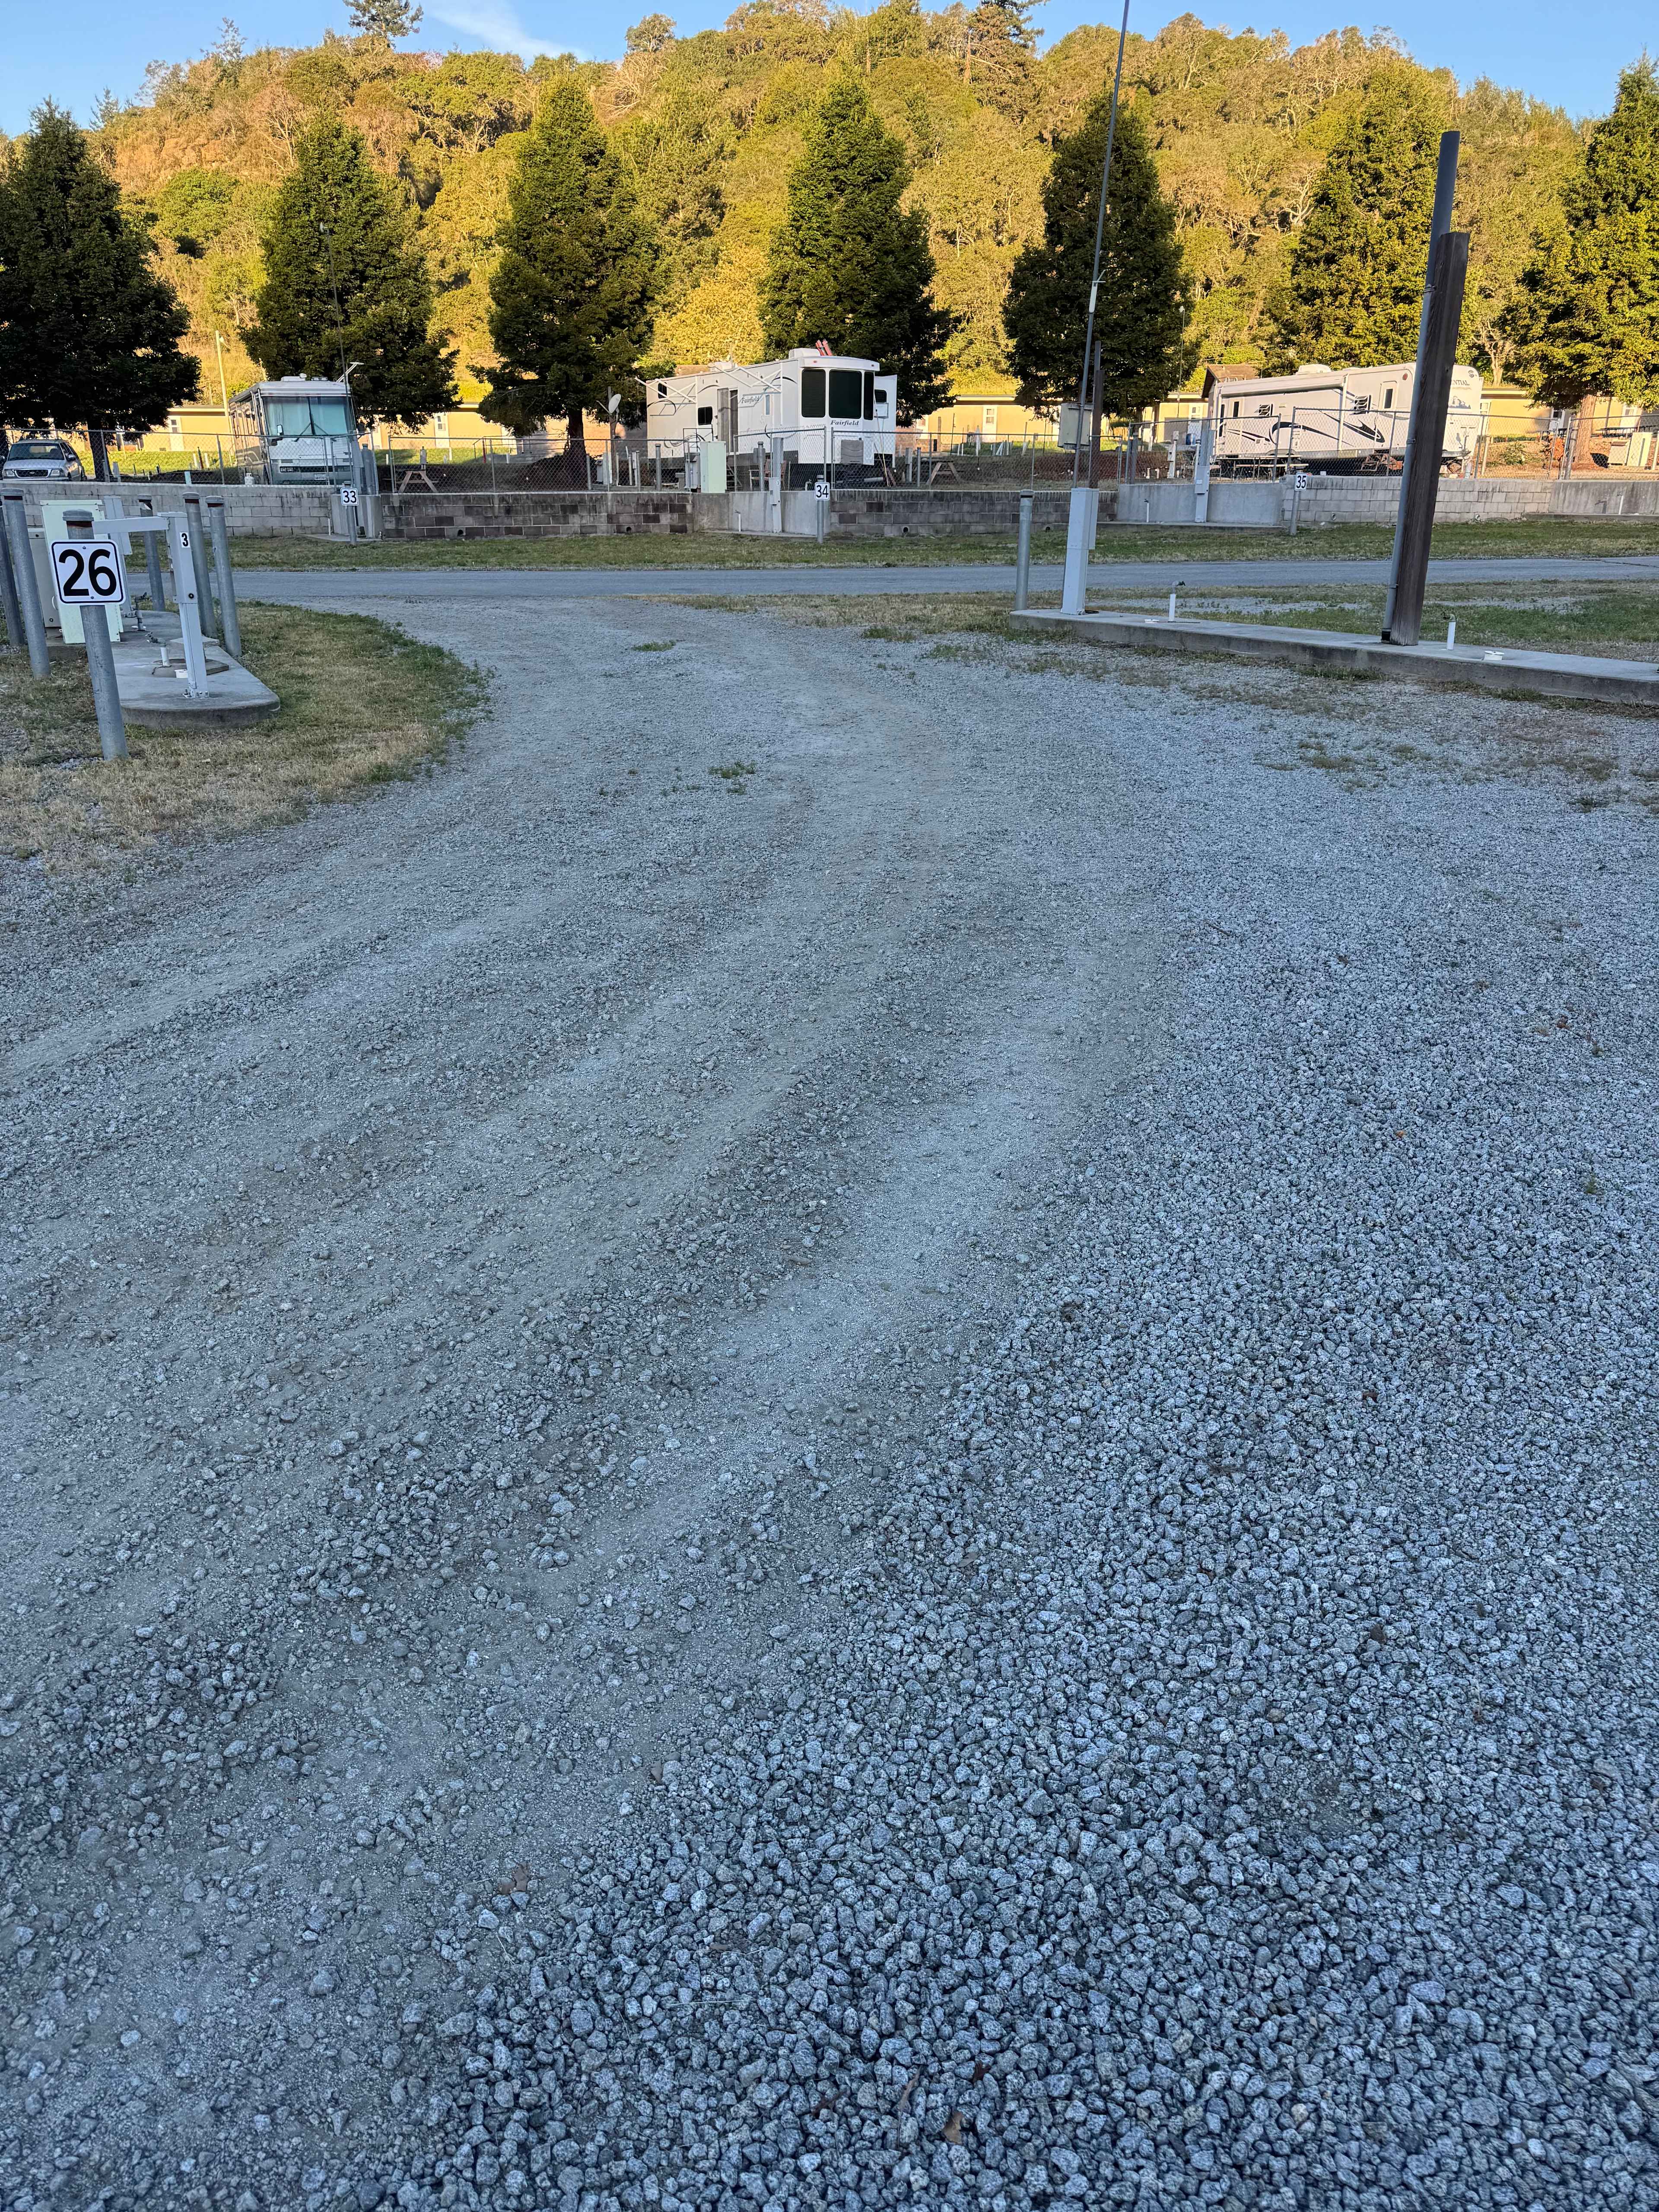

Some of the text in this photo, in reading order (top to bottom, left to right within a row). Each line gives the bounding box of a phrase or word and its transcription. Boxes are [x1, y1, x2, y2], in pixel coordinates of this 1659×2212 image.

[1296, 475, 1306, 488] 35
[343, 490, 356, 503] 33
[816, 485, 829, 498] 34
[181, 533, 188, 547] 3
[59, 549, 117, 596] 26
